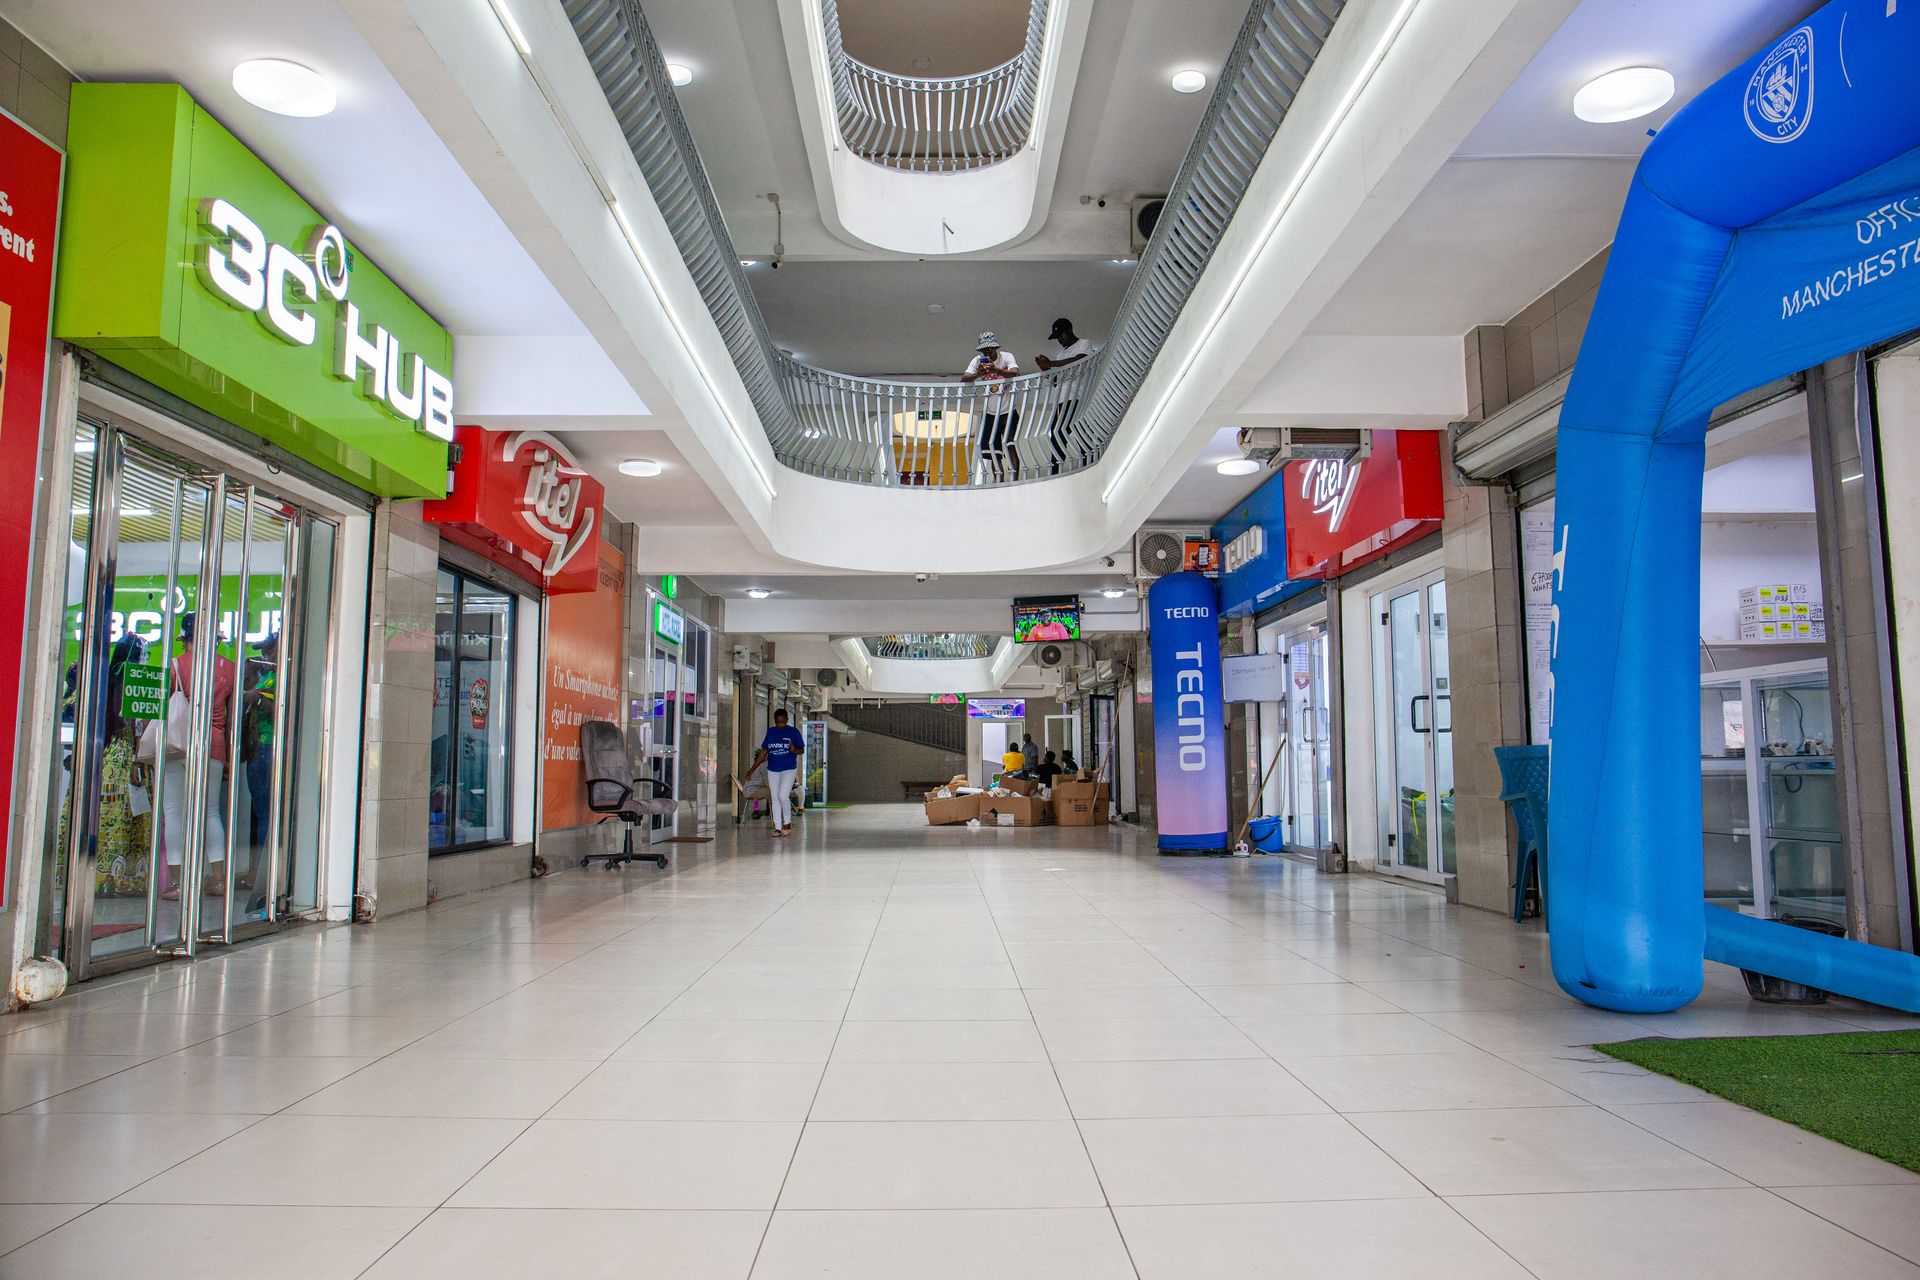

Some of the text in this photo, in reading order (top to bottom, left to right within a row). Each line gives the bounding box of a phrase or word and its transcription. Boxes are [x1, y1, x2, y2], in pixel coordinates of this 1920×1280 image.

[1777, 116, 1799, 136] CITY
[206, 198, 455, 443] 3C HUB
[524, 449, 582, 530] itel
[1164, 606, 1209, 620] TECNO
[125, 684, 167, 700] OUVERT
[131, 701, 160, 714] OPEN
[1175, 642, 1206, 772] TECNO
